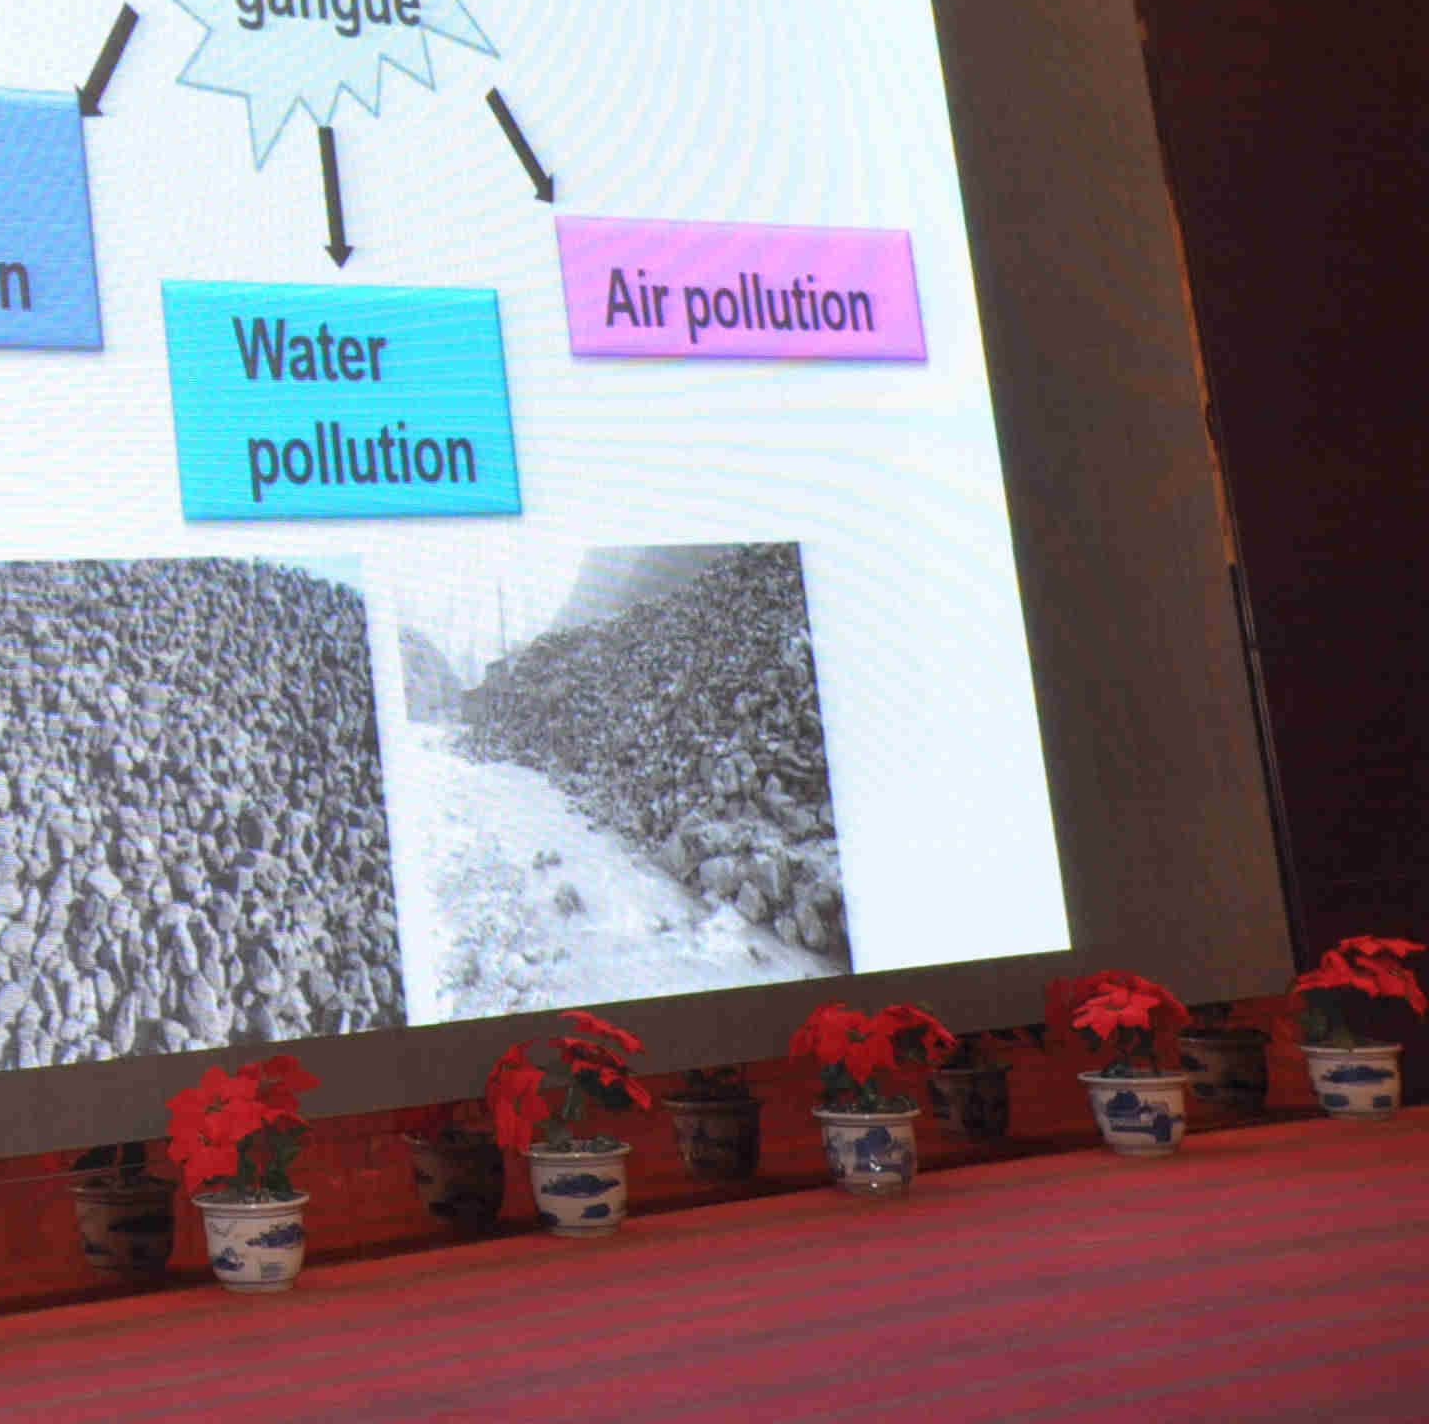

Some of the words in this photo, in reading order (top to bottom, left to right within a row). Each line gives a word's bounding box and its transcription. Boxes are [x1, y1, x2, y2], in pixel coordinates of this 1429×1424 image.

[605, 266, 669, 328] Air
[683, 273, 873, 342] pollution
[233, 316, 387, 382] Water
[247, 422, 476, 501] pollution
